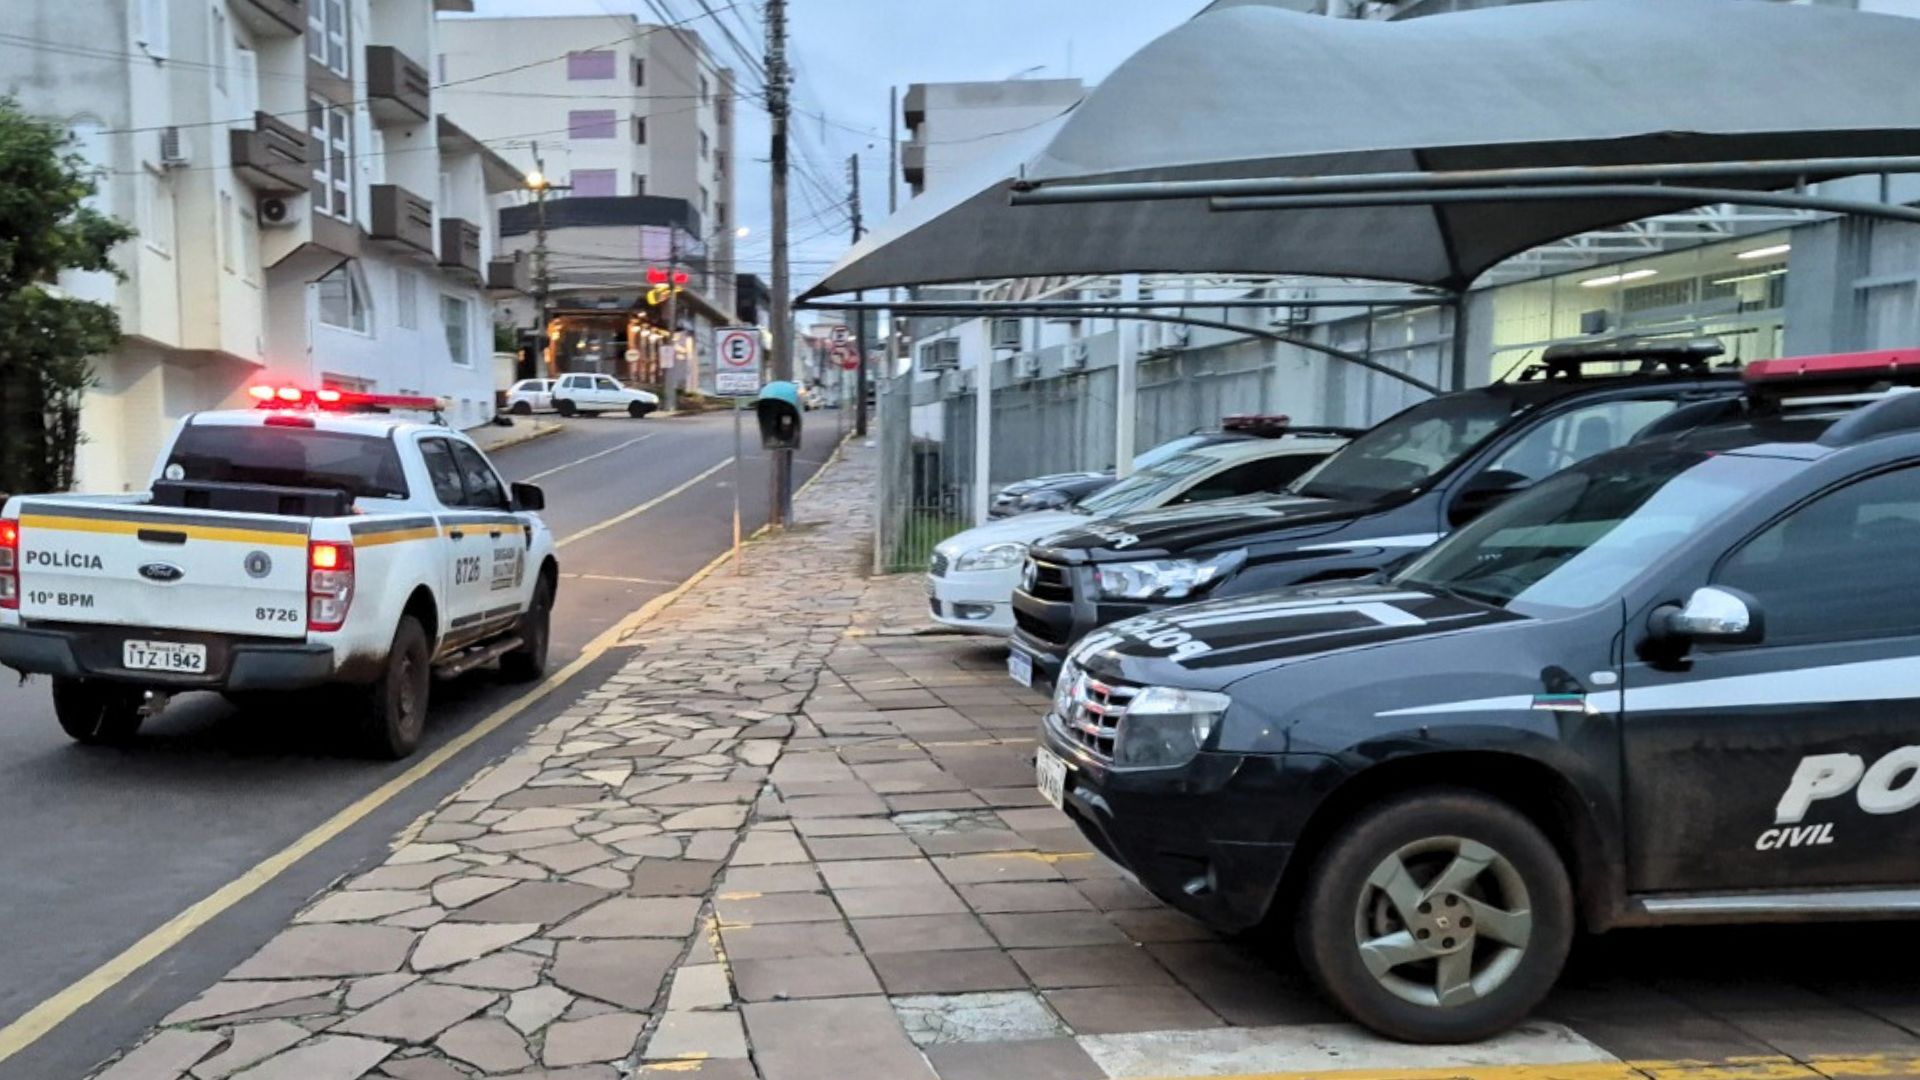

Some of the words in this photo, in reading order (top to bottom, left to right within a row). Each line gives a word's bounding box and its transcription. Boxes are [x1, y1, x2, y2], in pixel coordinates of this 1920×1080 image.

[731, 339, 744, 359] E
[26, 549, 103, 570] POLÍCIA
[57, 593, 94, 608] BPM
[255, 606, 298, 622] 8726
[1755, 822, 1834, 850] CIVIL
